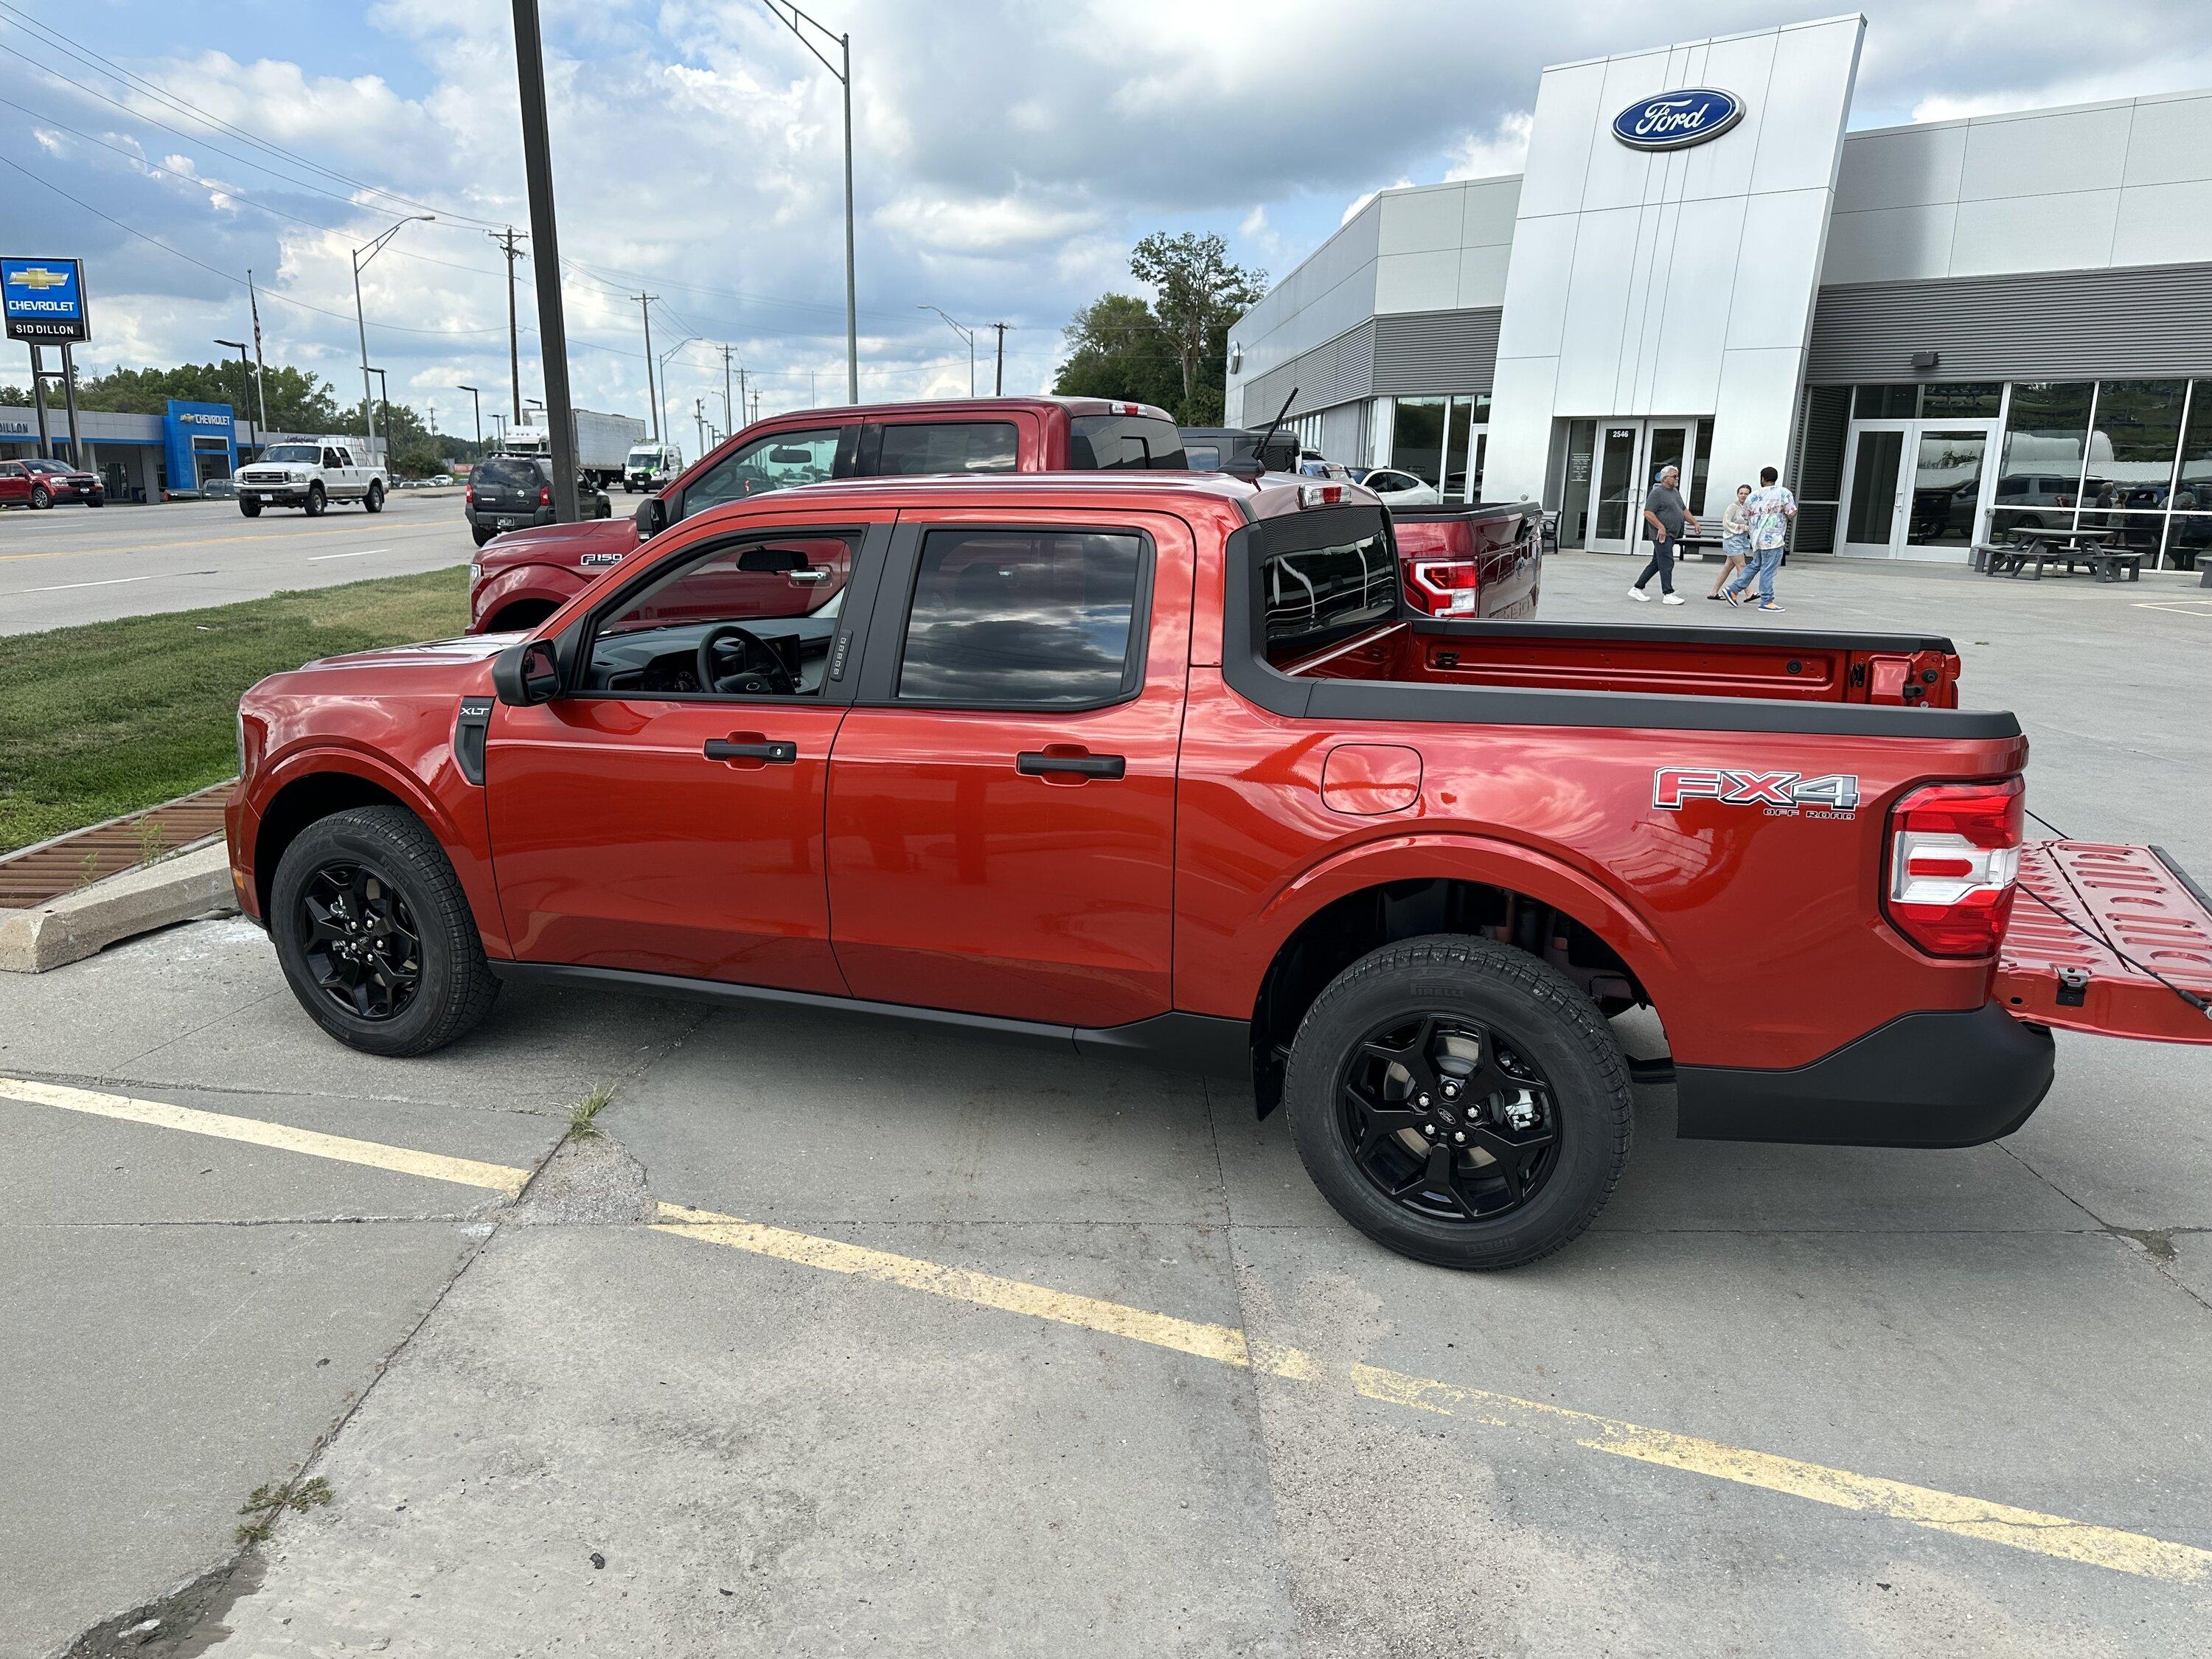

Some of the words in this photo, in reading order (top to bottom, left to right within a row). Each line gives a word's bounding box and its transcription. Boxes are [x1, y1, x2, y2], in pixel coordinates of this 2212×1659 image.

[1635, 99, 1710, 135] Ford
[8, 300, 74, 312] CHEVROLET
[15, 324, 34, 333] SID
[36, 324, 74, 335] DILLON
[195, 414, 230, 425] CHEVROLET
[459, 707, 490, 715] XLT
[1652, 766, 1860, 811] FX4
[1763, 808, 1800, 817] OFF
[1806, 810, 1856, 821] ROAD
[1410, 983, 1465, 998] PIRELLI
